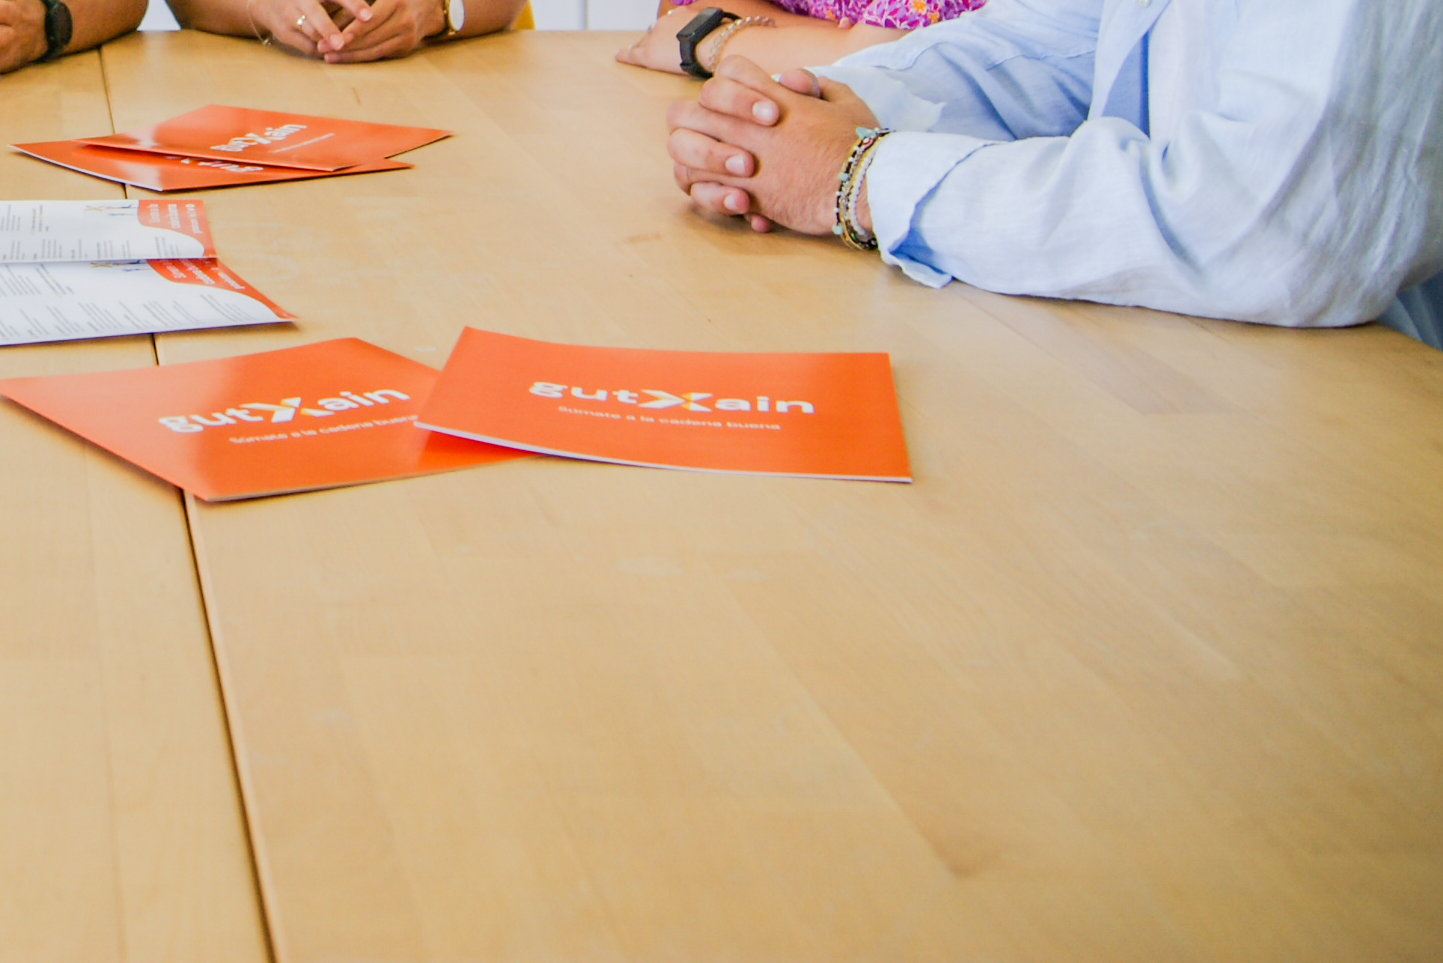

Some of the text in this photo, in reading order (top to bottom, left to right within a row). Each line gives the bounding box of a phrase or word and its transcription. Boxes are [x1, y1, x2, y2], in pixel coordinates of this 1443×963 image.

[528, 380, 815, 415] gutXain
[158, 388, 411, 434] gutXain
[319, 420, 374, 436] cadena
[659, 417, 722, 428] cadena
[726, 420, 781, 431] buena
